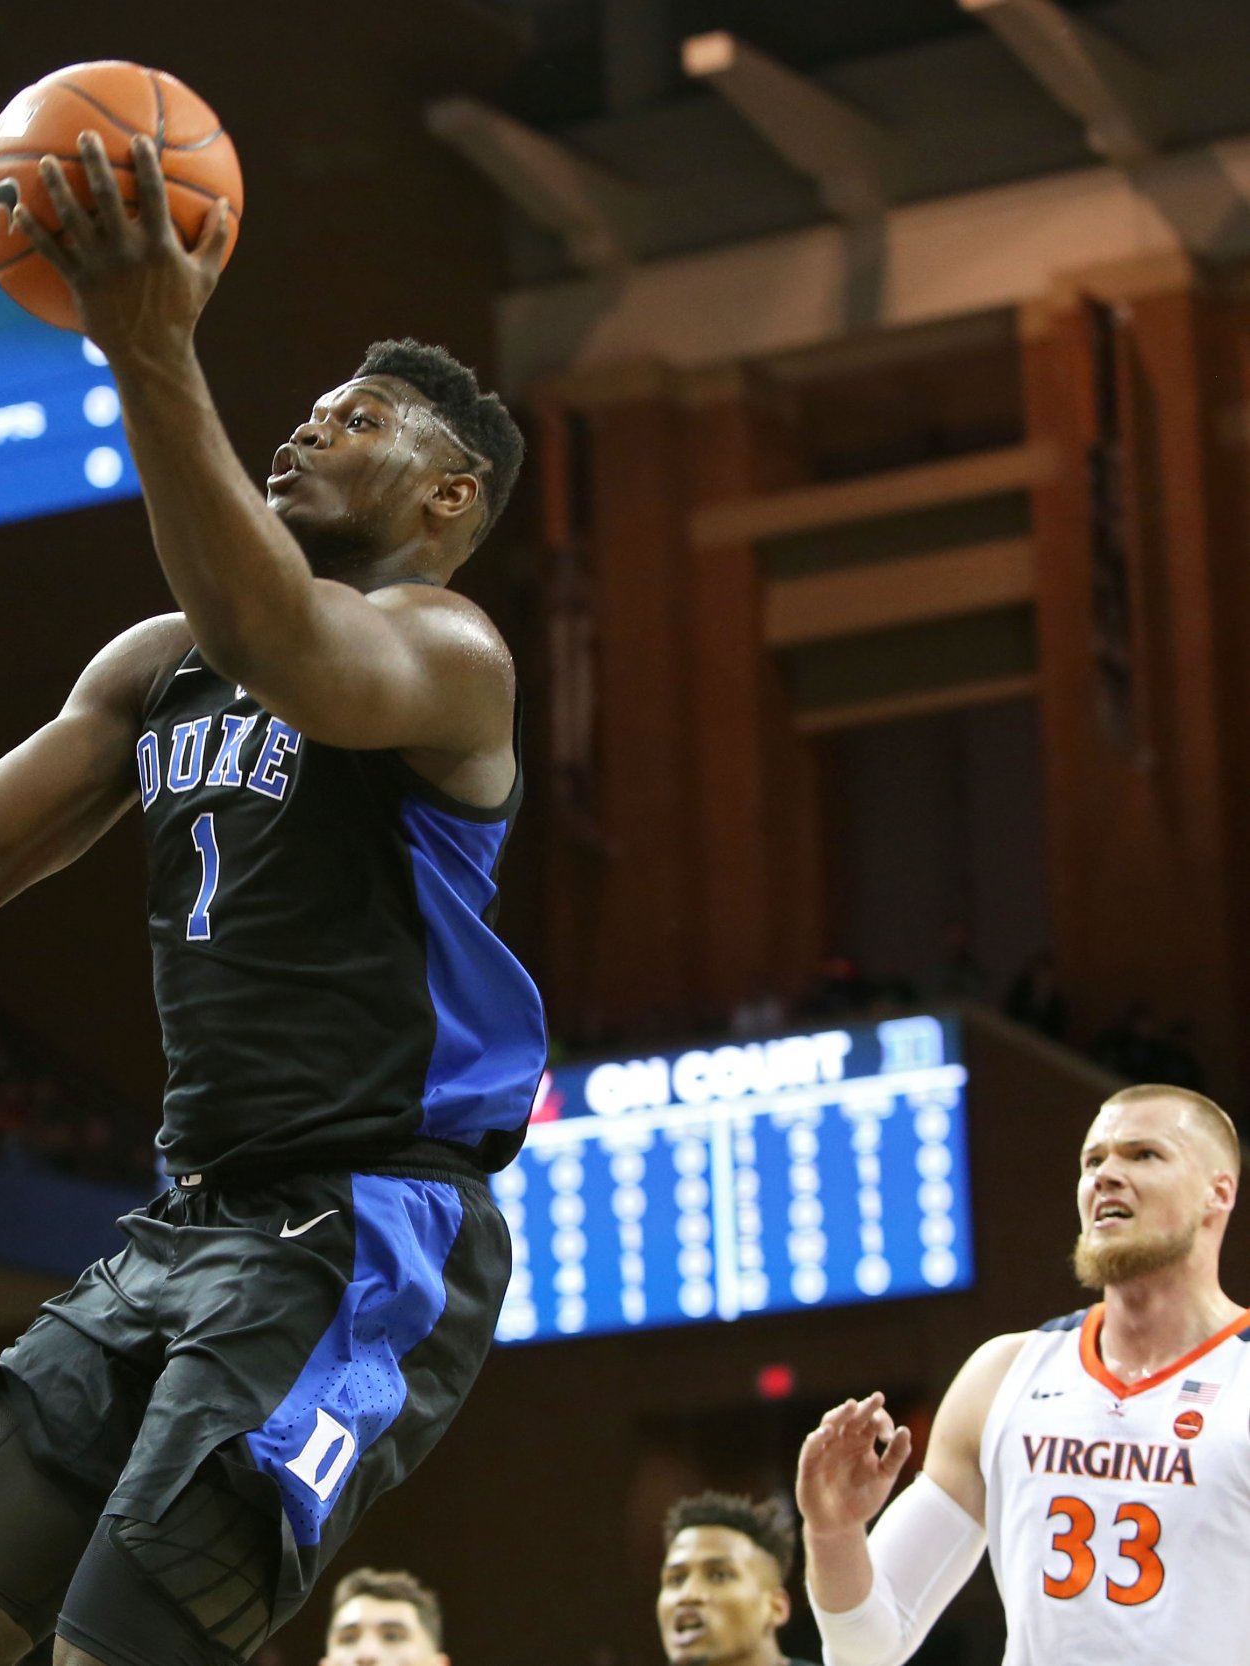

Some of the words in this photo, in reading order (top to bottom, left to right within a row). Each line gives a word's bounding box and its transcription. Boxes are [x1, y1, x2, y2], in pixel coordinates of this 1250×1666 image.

[136, 714, 301, 813] DUKE
[186, 812, 221, 941] 1
[586, 1058, 670, 1115] ON
[1022, 1434, 1197, 1486] VIRGINIA
[1043, 1495, 1165, 1606] 33
